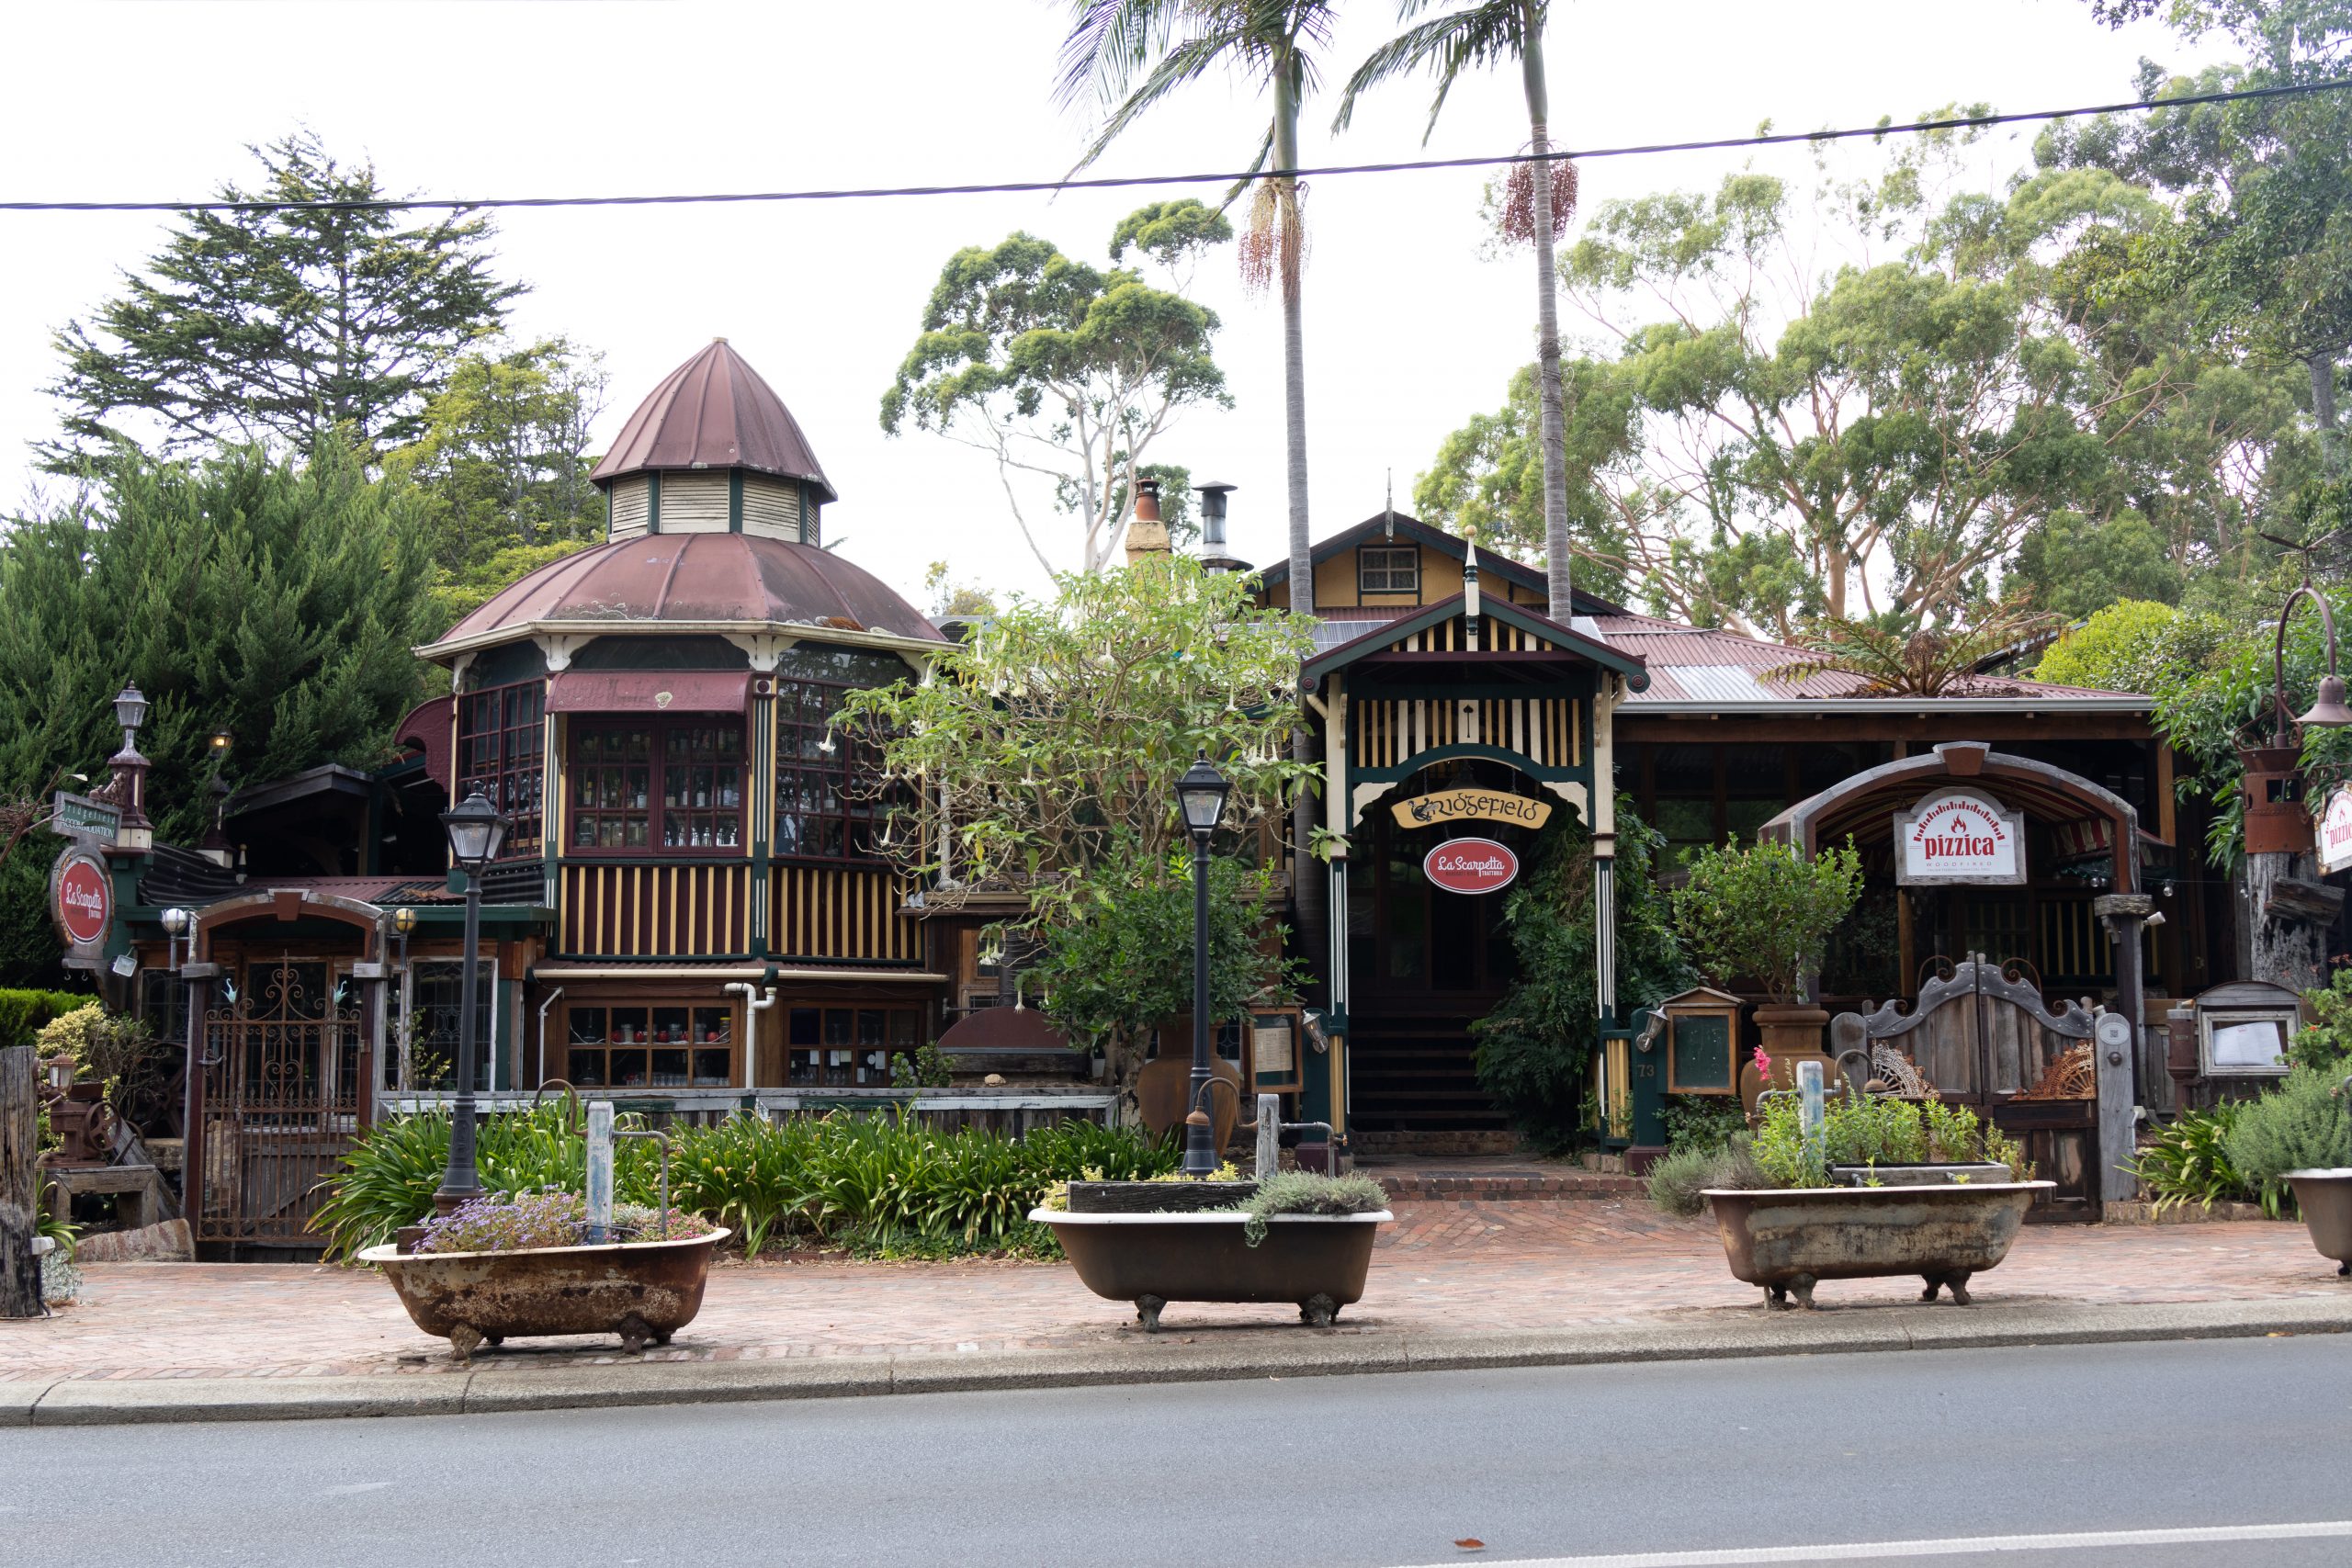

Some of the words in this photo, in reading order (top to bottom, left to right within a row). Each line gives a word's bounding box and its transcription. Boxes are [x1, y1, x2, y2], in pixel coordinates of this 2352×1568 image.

[1925, 834, 1995, 860] pizzica
[1438, 856, 1455, 871] La
[1455, 856, 1505, 878] Scarpetta
[66, 882, 76, 905] La
[1637, 1064, 1654, 1077] 73
